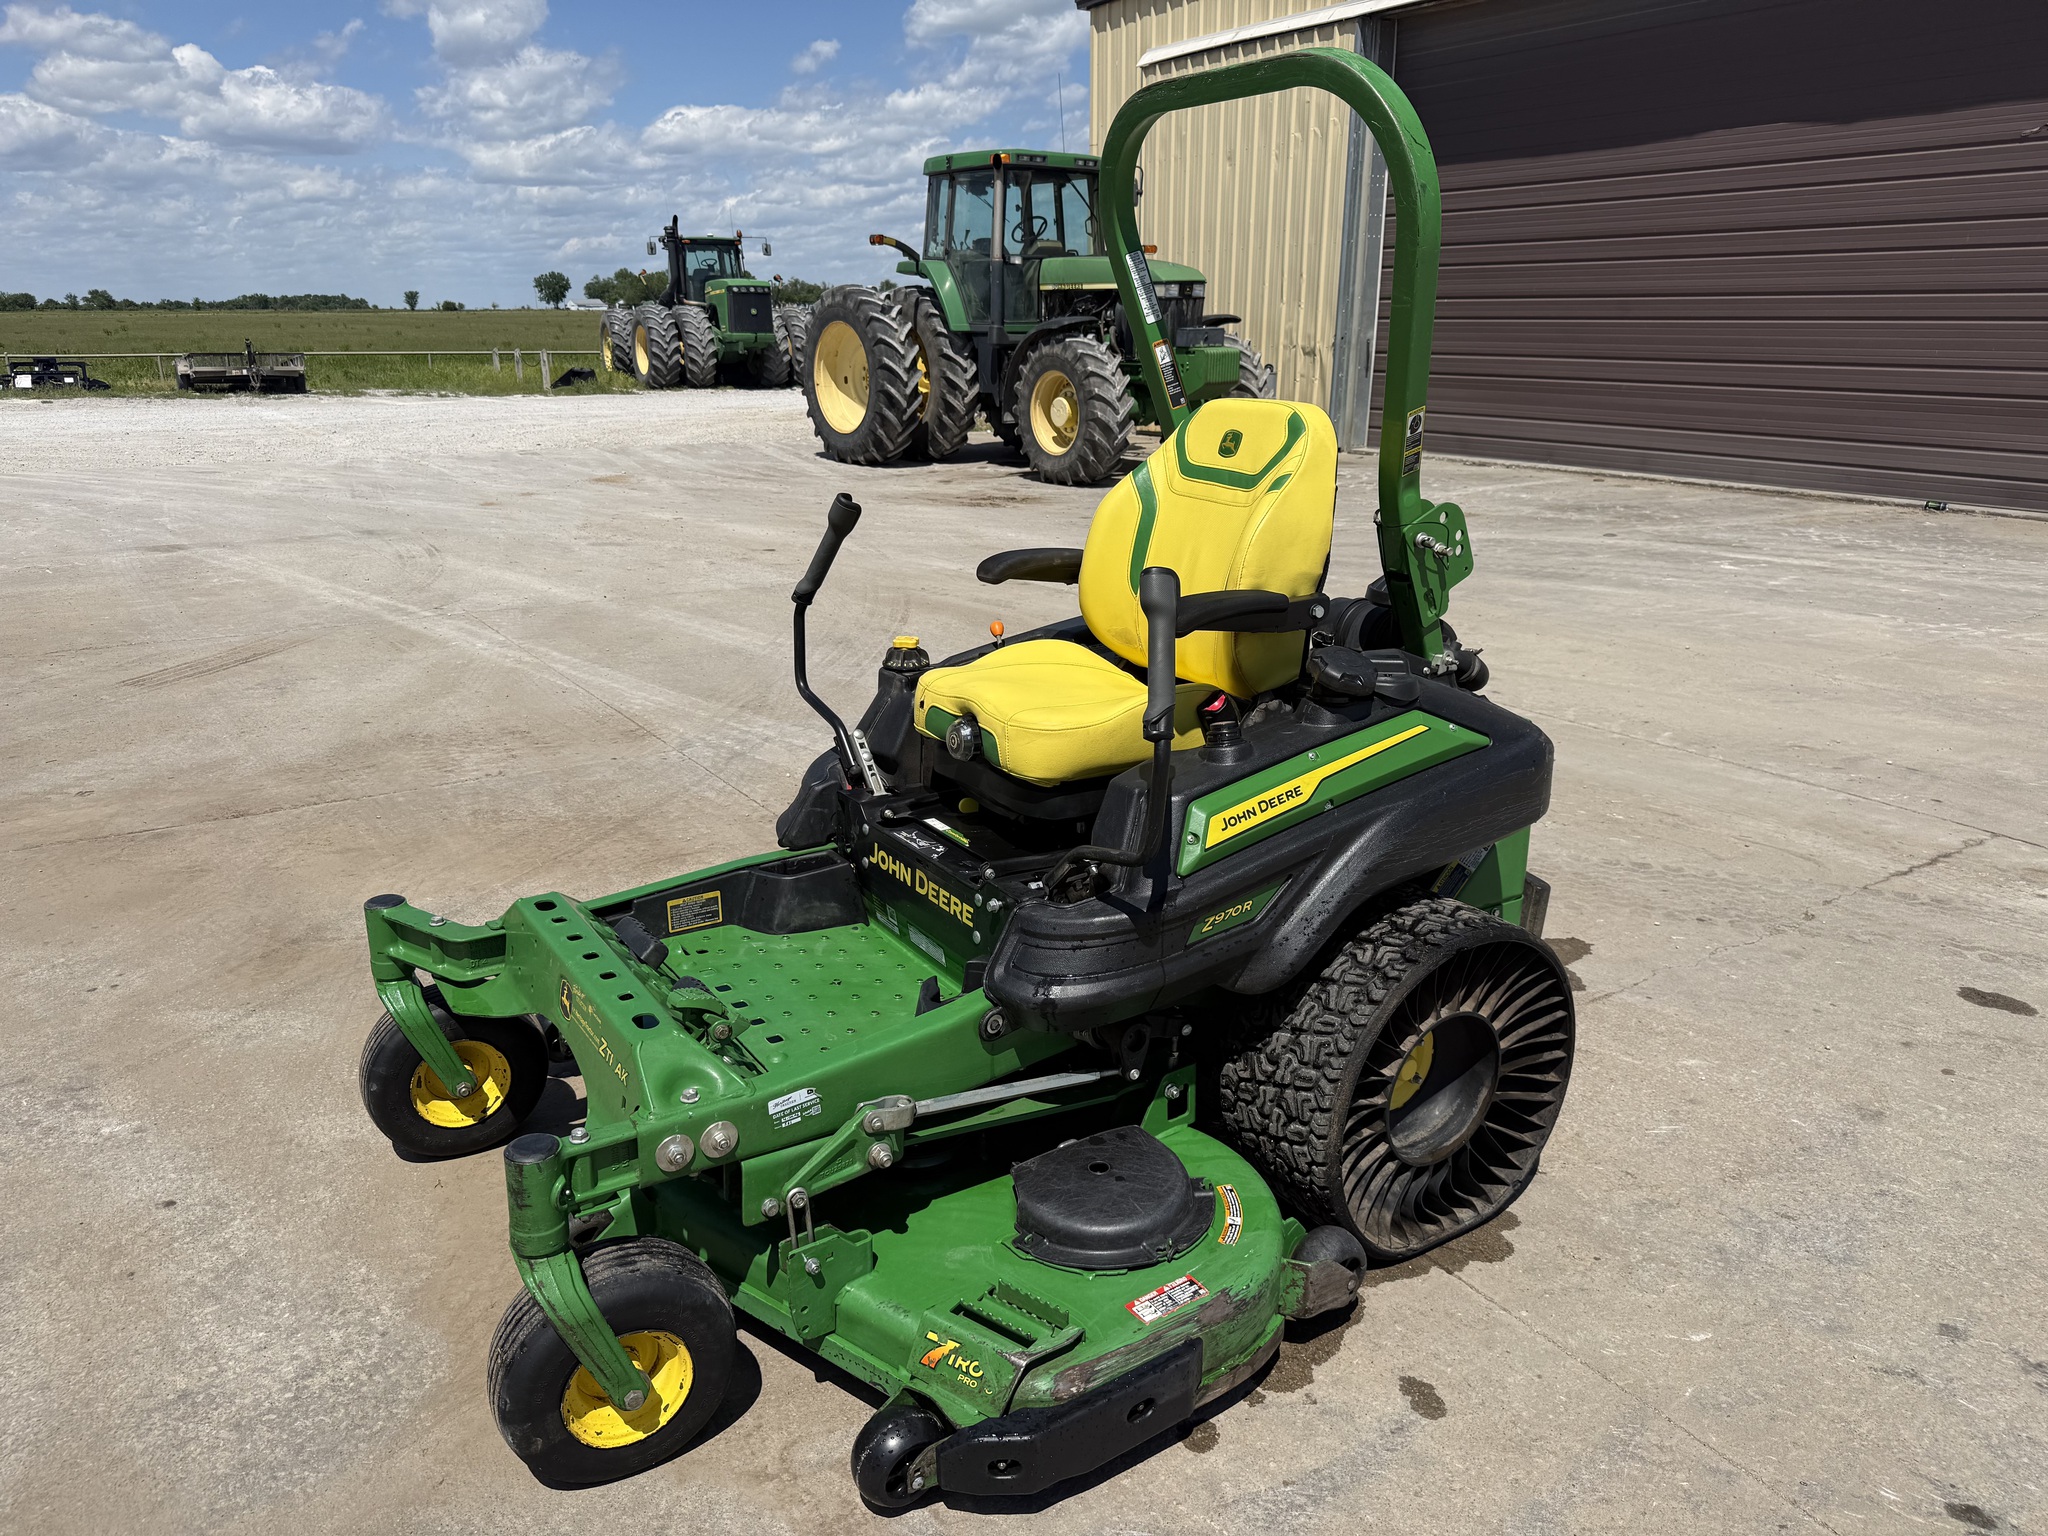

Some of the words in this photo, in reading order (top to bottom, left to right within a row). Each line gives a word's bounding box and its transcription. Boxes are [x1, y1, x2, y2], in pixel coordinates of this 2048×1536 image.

[1221, 806, 1257, 831] JOHN
[1257, 785, 1303, 814] DEERE
[869, 842, 911, 887] JOHN
[915, 869, 974, 928] DEERE
[1201, 900, 1253, 933] Z970R
[791, 1104, 802, 1112] LAST
[957, 1373, 978, 1388] PRO
